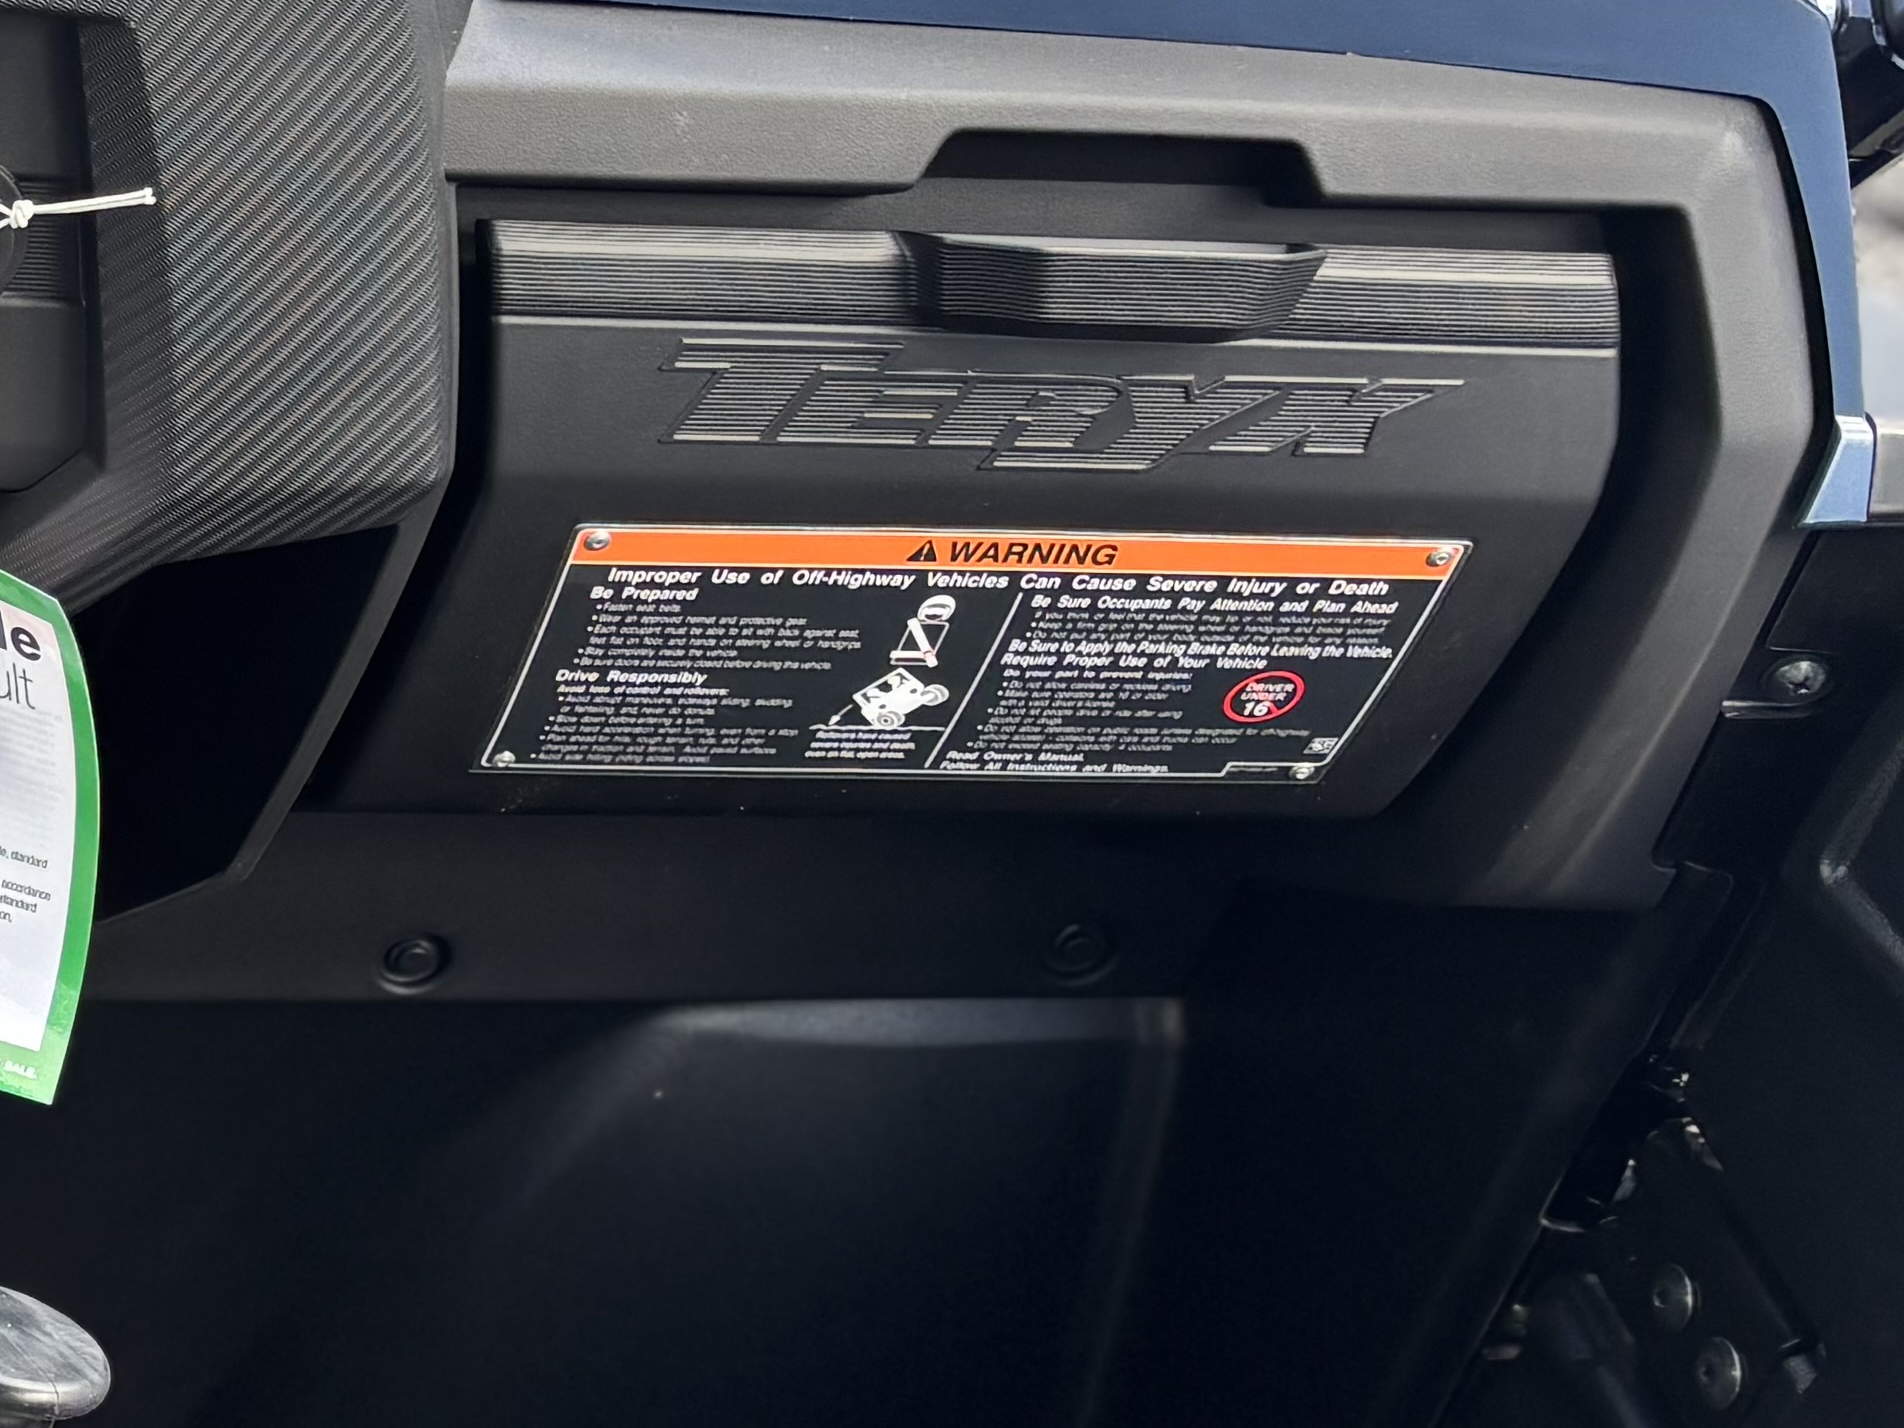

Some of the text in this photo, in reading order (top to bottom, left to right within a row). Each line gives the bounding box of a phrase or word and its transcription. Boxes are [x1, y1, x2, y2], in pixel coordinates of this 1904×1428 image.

[949, 541, 1119, 566] WARNING
[607, 566, 1390, 597] Improper Use of Off-Highway Vehicles Can Cause Severe Injury or Death
[589, 584, 700, 602] Be Prepared
[1030, 592, 1399, 614] Be Sure Occupants Pay Attention and Plan Ahead
[1008, 637, 1026, 651] Be
[1028, 638, 1059, 652] Sure
[1060, 639, 1073, 652] to
[1075, 640, 1113, 656] Apply
[1114, 641, 1136, 655] the
[1137, 642, 1184, 659] Parking
[1188, 642, 1225, 655] Brake
[1226, 642, 1269, 656] Before
[1270, 643, 1322, 660] Leaving
[1323, 644, 1344, 657] the
[1346, 644, 1393, 658] Vehicle.
[1000, 651, 1267, 671] Require Proper Use of Your Vehicle
[555, 667, 708, 688] Drive Responsibly
[1245, 682, 1295, 693] DRIVER
[1240, 691, 1287, 701] UNDER
[1243, 701, 1270, 716] 16
